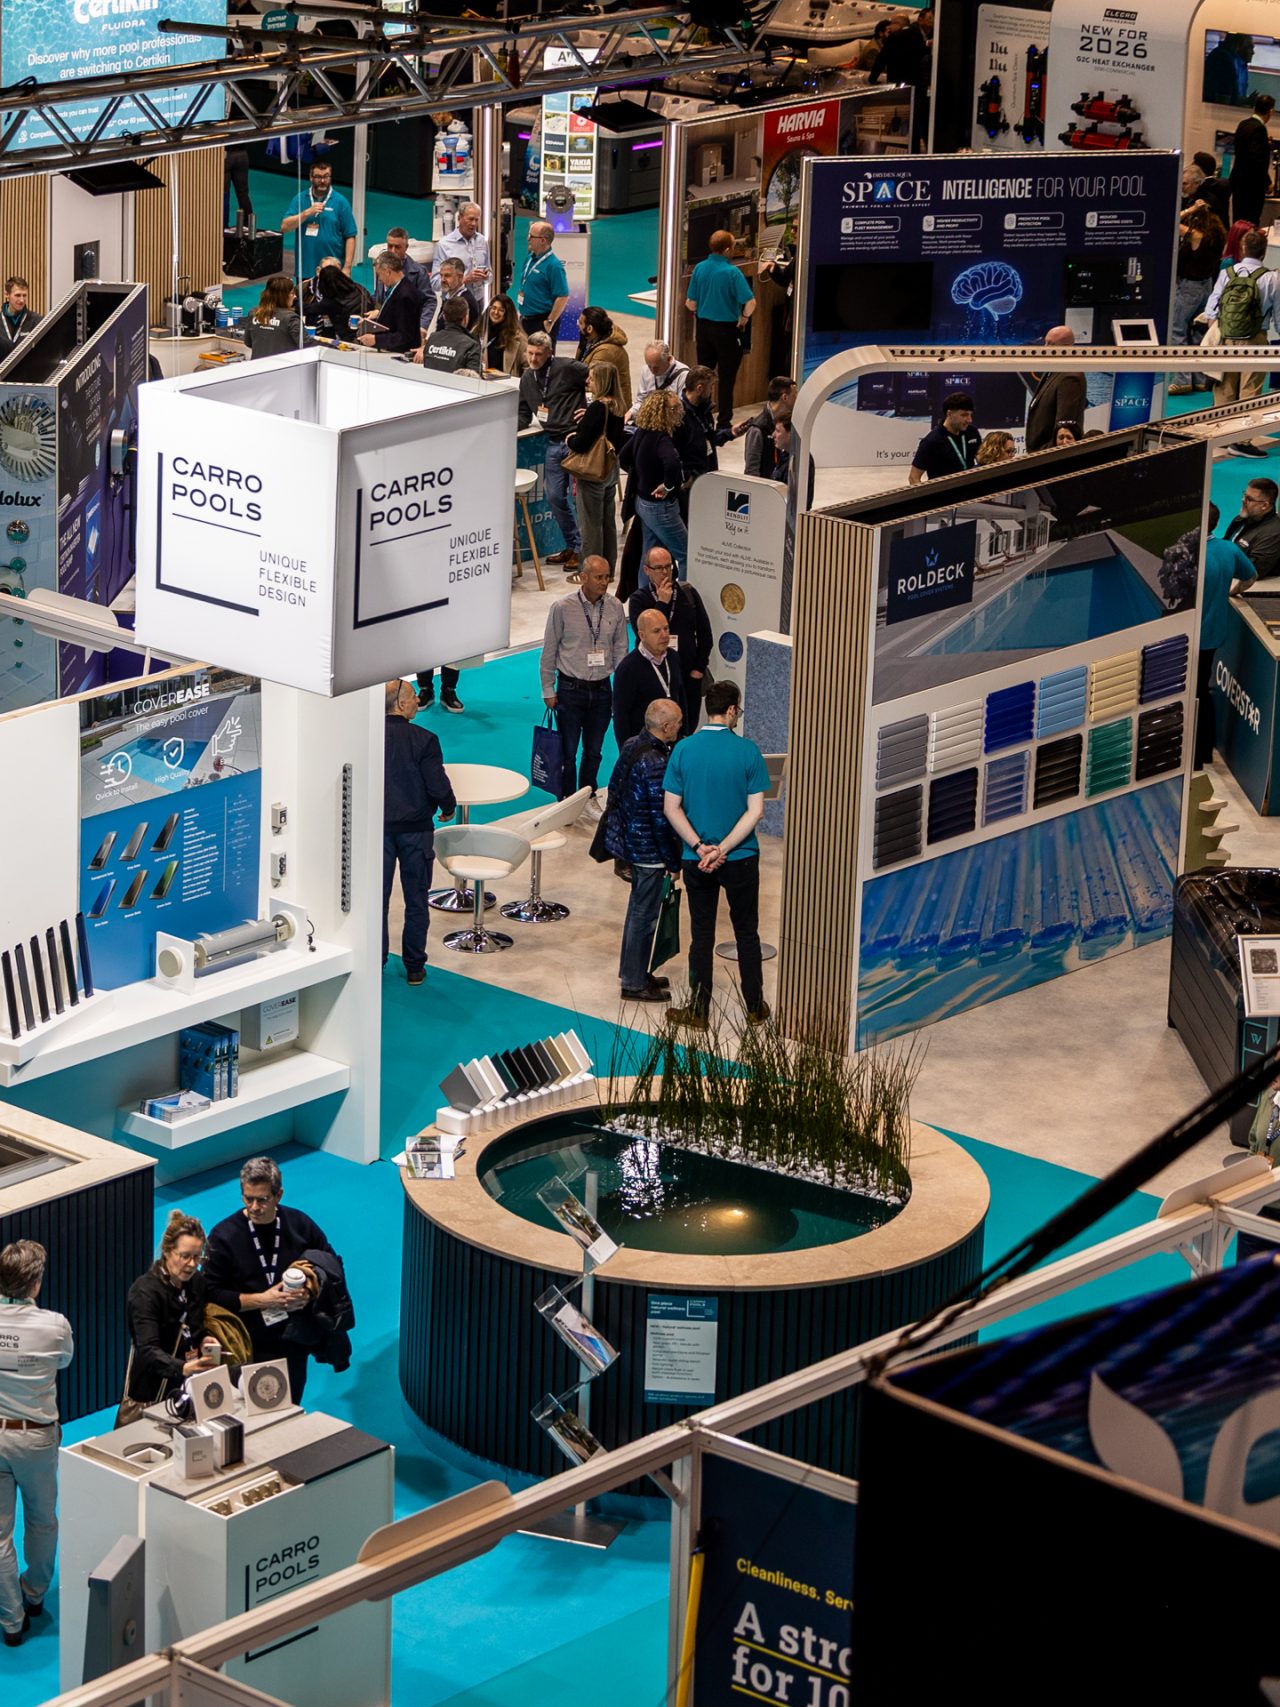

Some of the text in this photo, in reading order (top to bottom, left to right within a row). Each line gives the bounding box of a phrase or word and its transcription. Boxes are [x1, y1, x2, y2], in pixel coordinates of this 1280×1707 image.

[102, 20, 146, 31] FLUIDRA
[1106, 10, 1137, 20] ELEGRO
[1081, 25, 1148, 40] NEW FOR
[27, 34, 202, 66] Discover why more pool professionals
[1080, 36, 1148, 58] 2026
[60, 53, 170, 78] are switching to Certikin
[1092, 58, 1155, 71] HEAT EXCHANGER
[777, 108, 826, 134] HARVIA
[842, 180, 931, 204] SPACE
[942, 176, 1147, 200] INTELLIGENCE FOR YOUR POOL
[428, 344, 456, 357] Certikin
[945, 377, 971, 385] SPACE
[1115, 398, 1149, 407] SPACE
[172, 456, 263, 493] CARRO
[370, 466, 454, 503] CARRO
[172, 483, 262, 522] POOLS
[370, 494, 453, 532] POOLS
[726, 512, 749, 521] RENOLIT
[449, 528, 492, 549] UNIQUE
[259, 550, 307, 573] UNIQUE
[449, 542, 500, 567] FLEXIBLE
[259, 567, 317, 593] FLEXIBLE
[448, 562, 490, 584] DESIGN
[897, 563, 965, 595] ROLDECK
[258, 584, 306, 607] DESIGN
[133, 683, 210, 716] COVEREASE
[135, 705, 209, 734] The easy pool cover
[256, 1535, 320, 1573] CARRO
[255, 1554, 319, 1593] POOLS
[736, 1558, 820, 1601] Cleanliness.
[734, 1601, 765, 1644] A
[732, 1644, 794, 1701] for
